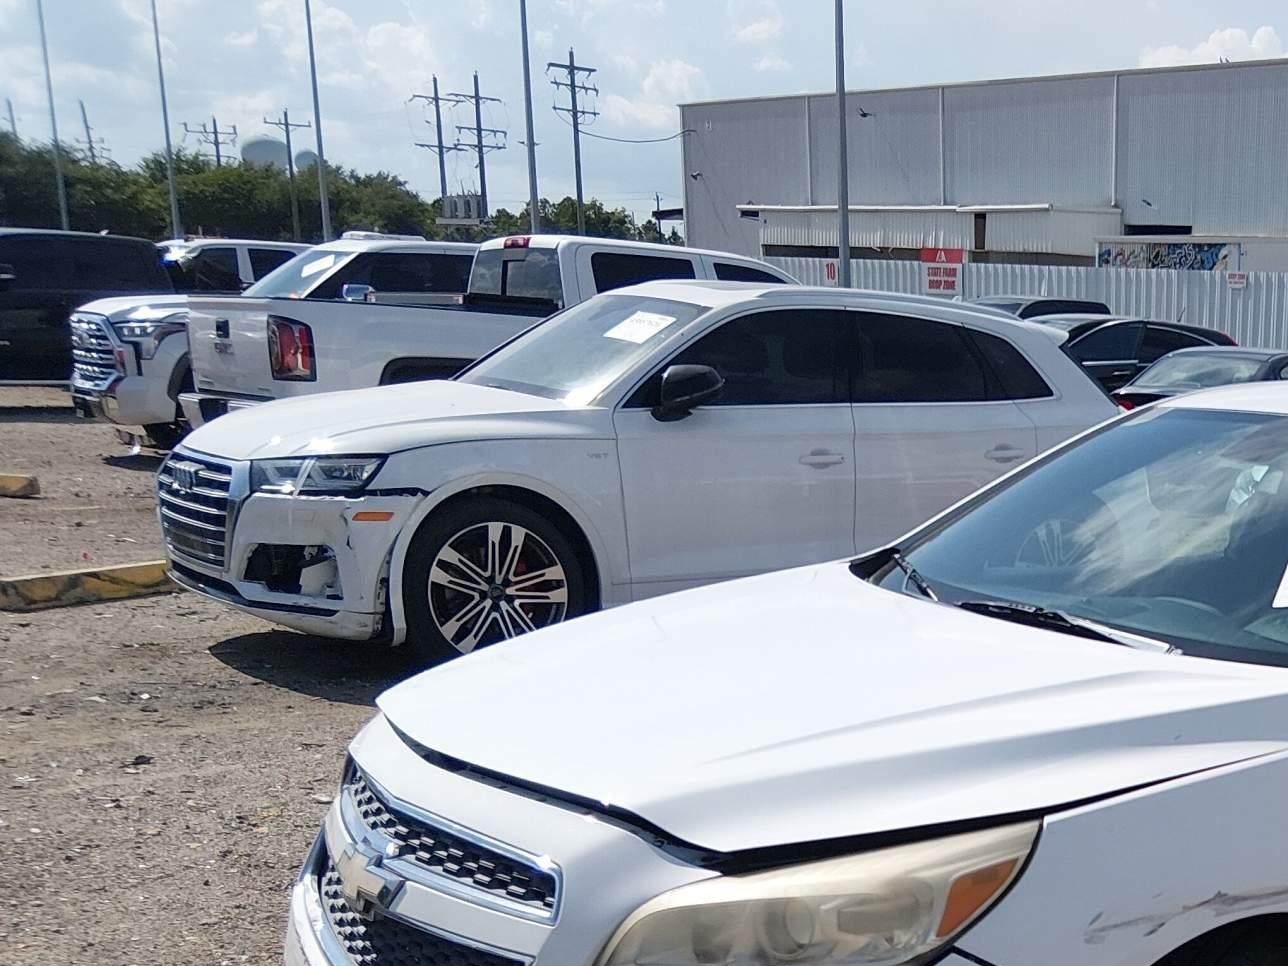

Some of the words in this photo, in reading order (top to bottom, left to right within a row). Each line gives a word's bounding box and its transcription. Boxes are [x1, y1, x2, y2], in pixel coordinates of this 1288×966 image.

[825, 262, 836, 281] 10
[928, 279, 942, 290] DROP
[943, 280, 956, 290] ZONE
